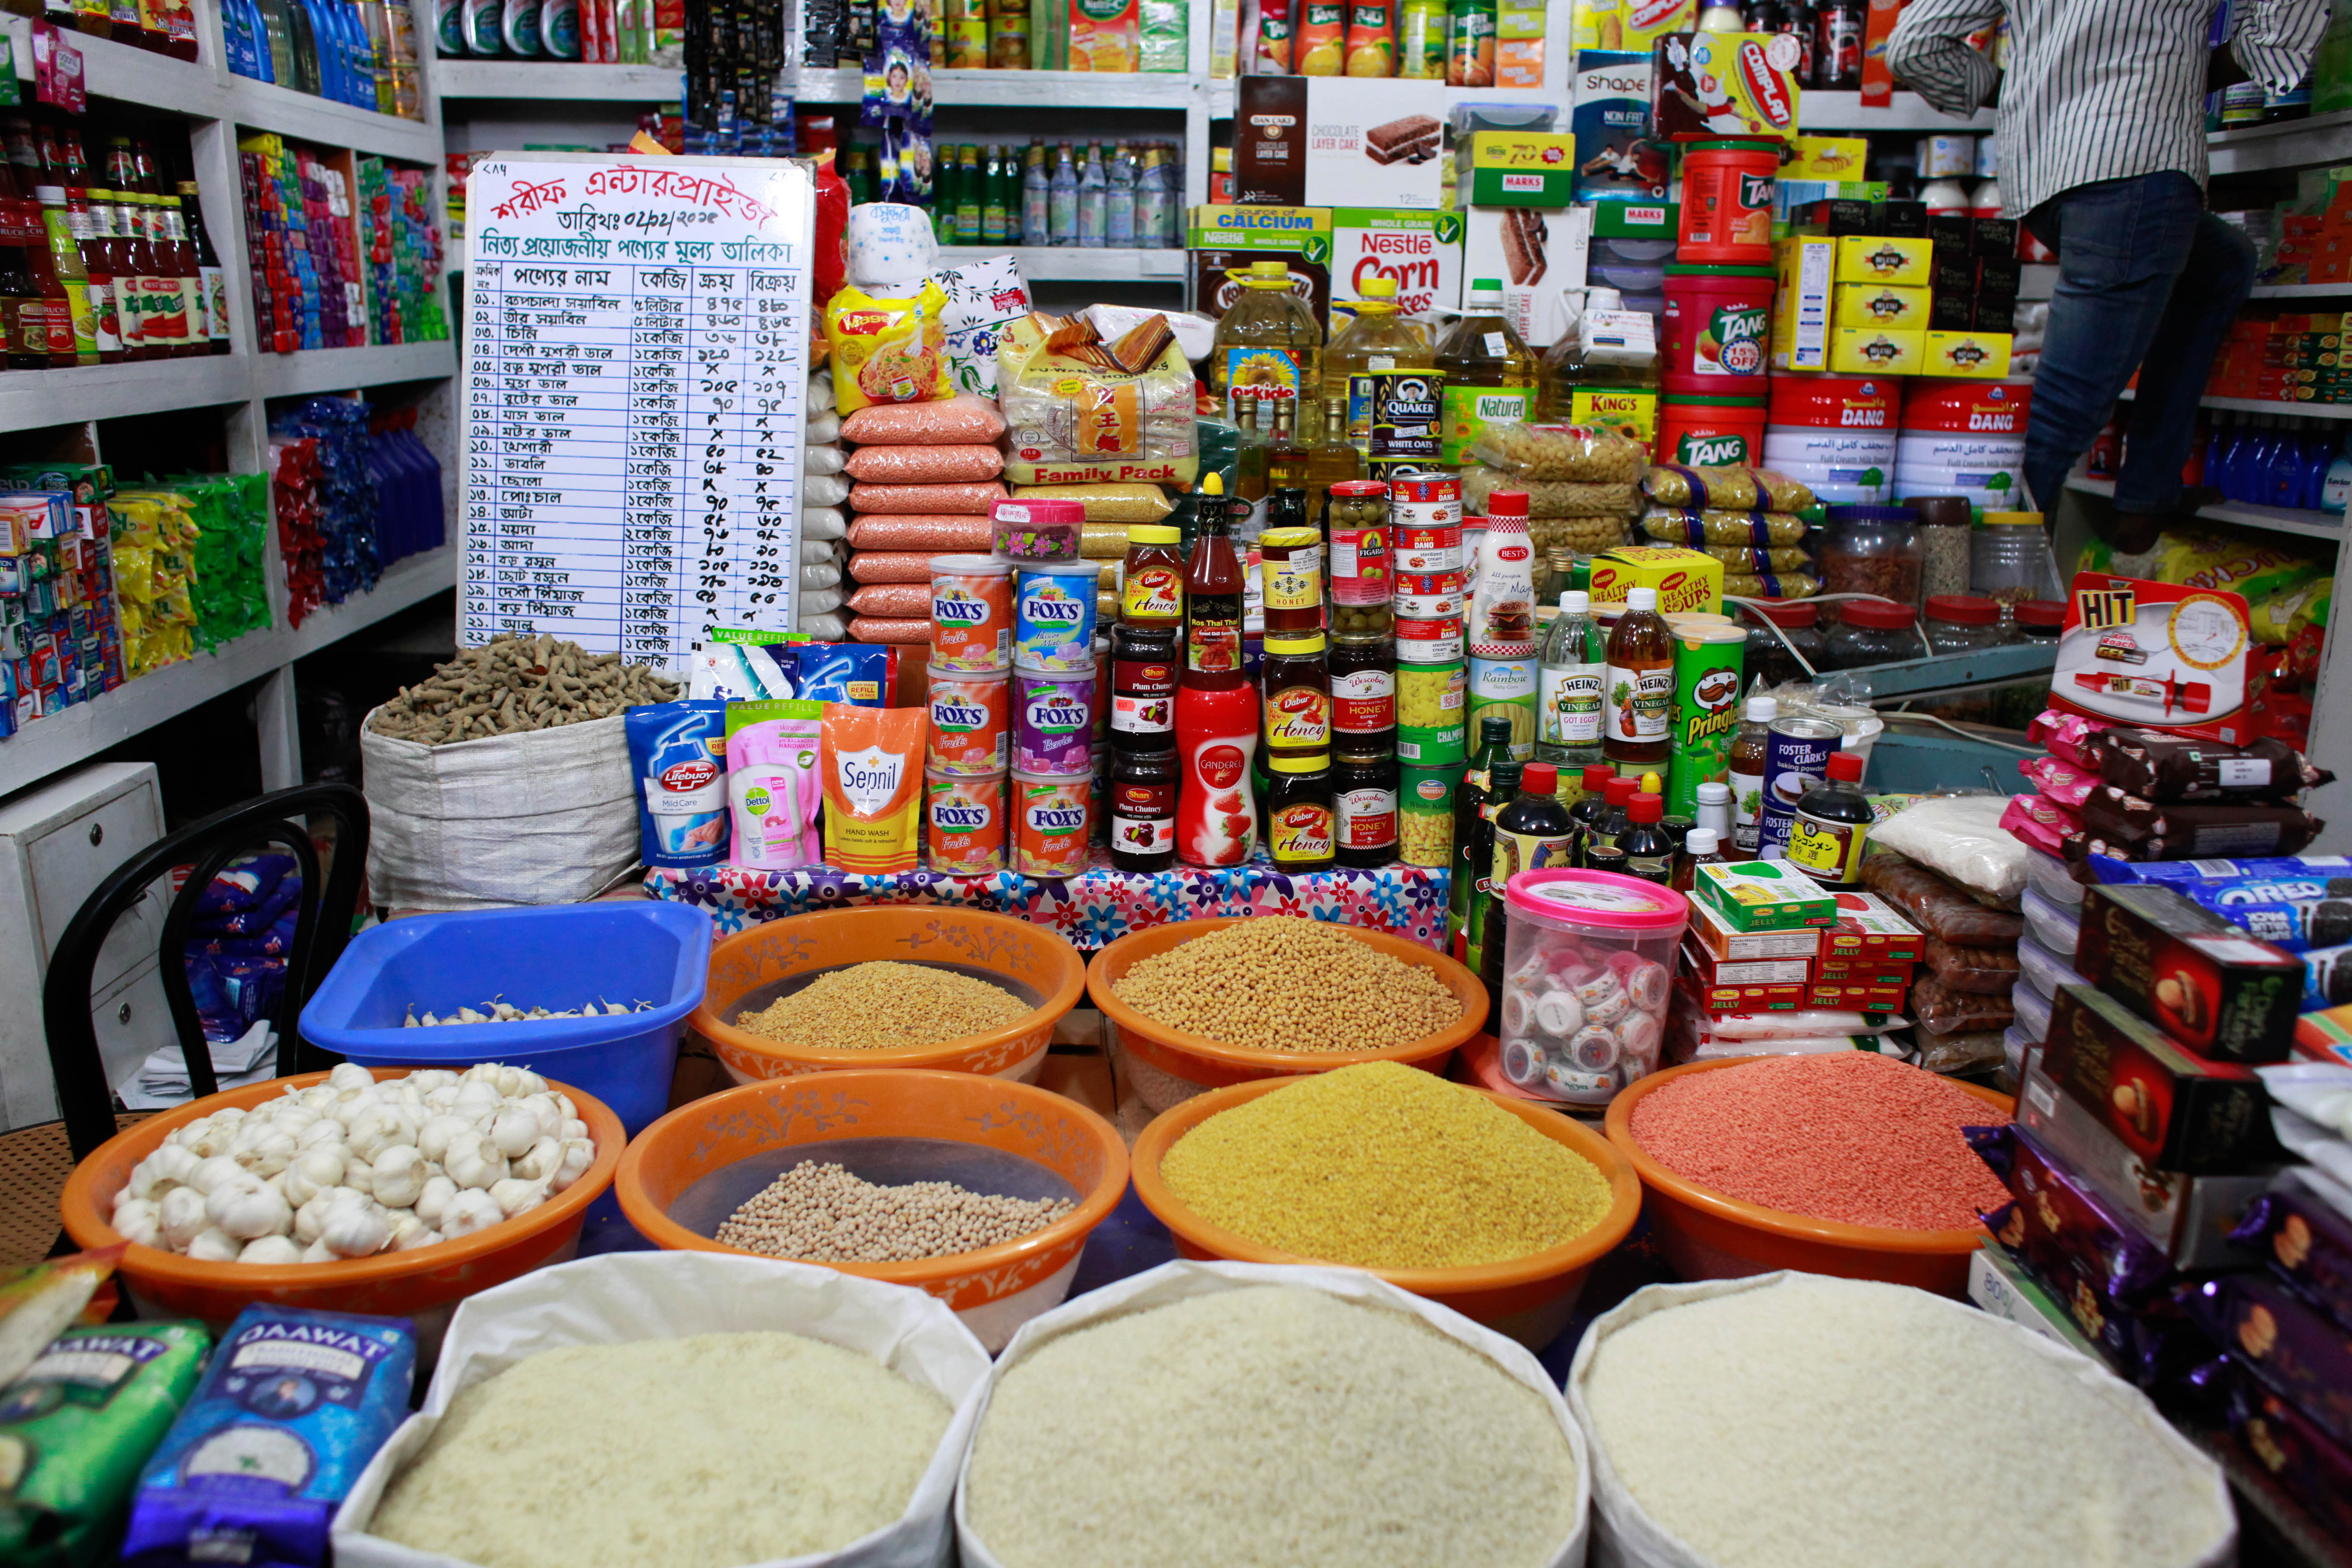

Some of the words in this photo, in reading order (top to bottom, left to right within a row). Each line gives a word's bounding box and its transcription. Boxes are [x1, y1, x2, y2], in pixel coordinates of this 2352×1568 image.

[1587, 75, 1645, 92] shape
[1743, 44, 1790, 123] COMPLAN
[1604, 111, 1623, 121] NON
[1312, 125, 1359, 137] CHOCOLATE
[1312, 139, 1336, 150] LAYER
[1340, 139, 1359, 150] CAKE
[1505, 176, 1541, 186] MARKS
[490, 178, 566, 219] শরীফ
[1627, 210, 1661, 219] MARKS
[1217, 215, 1313, 230] CALCIUM
[480, 227, 519, 257] নিত্য
[522, 232, 611, 259] প্রয়োজনীয়
[618, 240, 669, 260] পণ্যের
[675, 241, 714, 264] মূল্য
[721, 235, 793, 263] তালিকা
[514, 268, 567, 287] পণ্যের
[575, 270, 611, 286] নাম
[640, 268, 688, 290] কেজি
[699, 273, 735, 292] ক্রয়
[750, 271, 797, 293] বিক্রয়
[505, 325, 537, 340] চিনি
[1719, 314, 1766, 344] TANG
[503, 343, 535, 357] দেশী
[584, 348, 613, 359] ডাল
[1730, 357, 1756, 366] OFF
[503, 362, 524, 375] বড়
[572, 365, 602, 376] ডাল
[538, 379, 568, 389] ডাল
[503, 392, 542, 405] বুটের
[548, 395, 579, 406] ডাল
[1591, 395, 1636, 412] KING'S
[1389, 402, 1434, 416] QUAKER
[1480, 397, 1524, 418] Naturel
[534, 412, 565, 421] ডাল
[542, 428, 572, 438] ডাল
[1387, 440, 1411, 449] WHITE
[1685, 440, 1741, 467] TANG
[1034, 467, 1112, 483] Family
[1119, 464, 1176, 480] Pack
[500, 505, 533, 519] আটা
[500, 524, 536, 536] ময়দা
[500, 540, 533, 551] আদা
[1359, 547, 1384, 557] FIGARO
[1501, 549, 1527, 558] BEST'S
[498, 555, 518, 567] বড়
[524, 557, 556, 568] রসুন
[532, 572, 569, 584] রসুন
[1145, 575, 1166, 585] Dabur
[1593, 573, 1614, 585] Maggi
[1662, 574, 1685, 589] Maggi
[498, 585, 531, 598] দেশী
[1510, 582, 1533, 597] Mayo
[1662, 575, 1709, 604] HEALTHY
[498, 603, 523, 616] বড়
[935, 600, 983, 620] FOX'S
[1028, 601, 1078, 620] FOX'S
[1134, 596, 1179, 615] Honey
[2080, 591, 2132, 629] HIT
[500, 619, 536, 632] আলু
[2102, 637, 2135, 649] Roach
[1349, 676, 1385, 687] Wescobee
[1482, 671, 1527, 684] Rainbow
[1639, 678, 1668, 690] HEINZ
[1566, 679, 1599, 691] HEINZ
[774, 703, 813, 712] REFILL
[1284, 696, 1310, 709] Dabur
[1560, 701, 1600, 711] VINEGAR
[1634, 699, 1669, 708] VINEGAR
[934, 707, 982, 725] FOX'S
[1034, 707, 1083, 725] FOX'S
[1349, 705, 1387, 714] HONEY
[1273, 719, 1326, 741] Honey
[1687, 703, 1740, 746] Pringle
[1779, 744, 1811, 754] FOSTER
[1794, 751, 1826, 764] CLARK'S
[1200, 760, 1243, 769] CANDEREL
[1777, 761, 1799, 771] baking
[665, 771, 713, 783] Lifebuoy
[843, 761, 896, 795] Sepnil
[1128, 790, 1149, 799] Shan
[1349, 793, 1385, 805] Wescobee
[745, 796, 770, 807] Dettol
[1119, 803, 1133, 811] Plum
[936, 806, 984, 825] FOX'S
[1289, 811, 1315, 823] Dabur
[1278, 834, 1331, 855] Honey
[2220, 880, 2324, 905] OREO
[1749, 918, 1777, 927] JELLY
